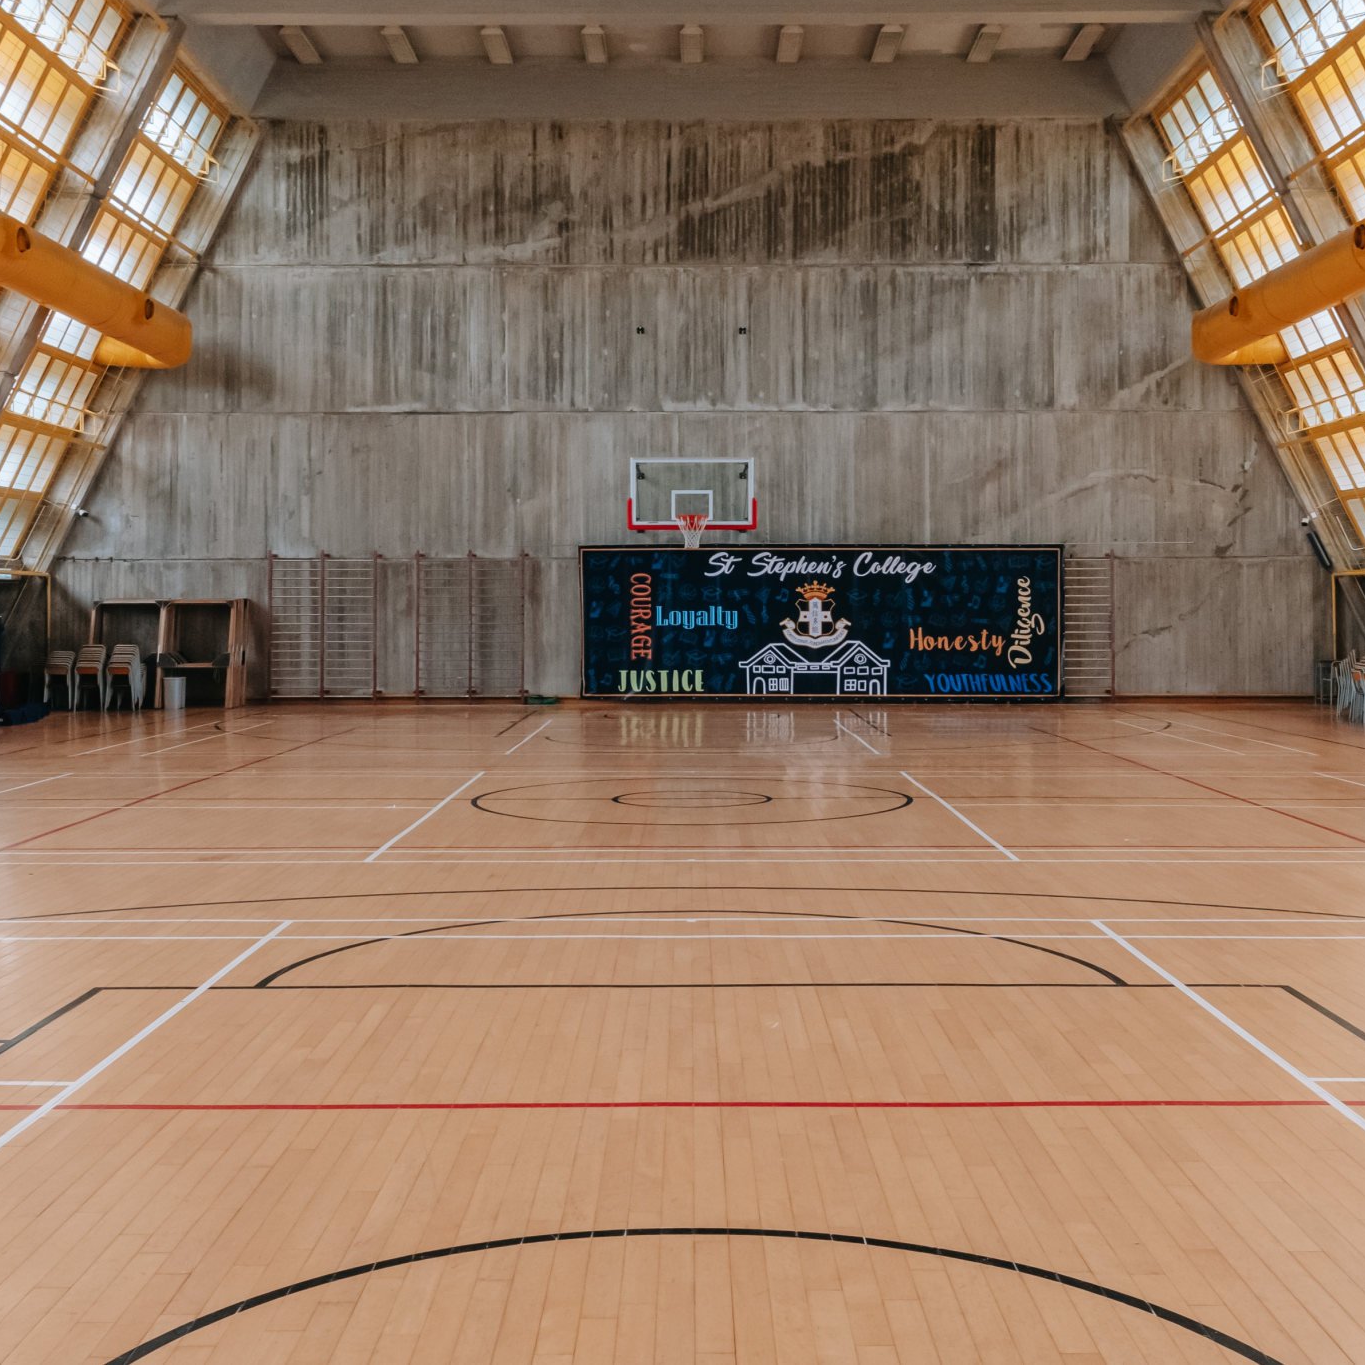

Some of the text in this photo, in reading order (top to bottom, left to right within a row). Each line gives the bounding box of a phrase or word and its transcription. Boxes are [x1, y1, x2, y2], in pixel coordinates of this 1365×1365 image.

[704, 552, 937, 584] St Stephen's College
[630, 573, 652, 661] COURAGE
[656, 605, 738, 630] Loyalty
[1007, 576, 1045, 669] Diligence
[909, 627, 1006, 656] Honesty
[618, 669, 705, 692] JUSTICE
[924, 673, 1053, 693] YOUTHFULNESS
